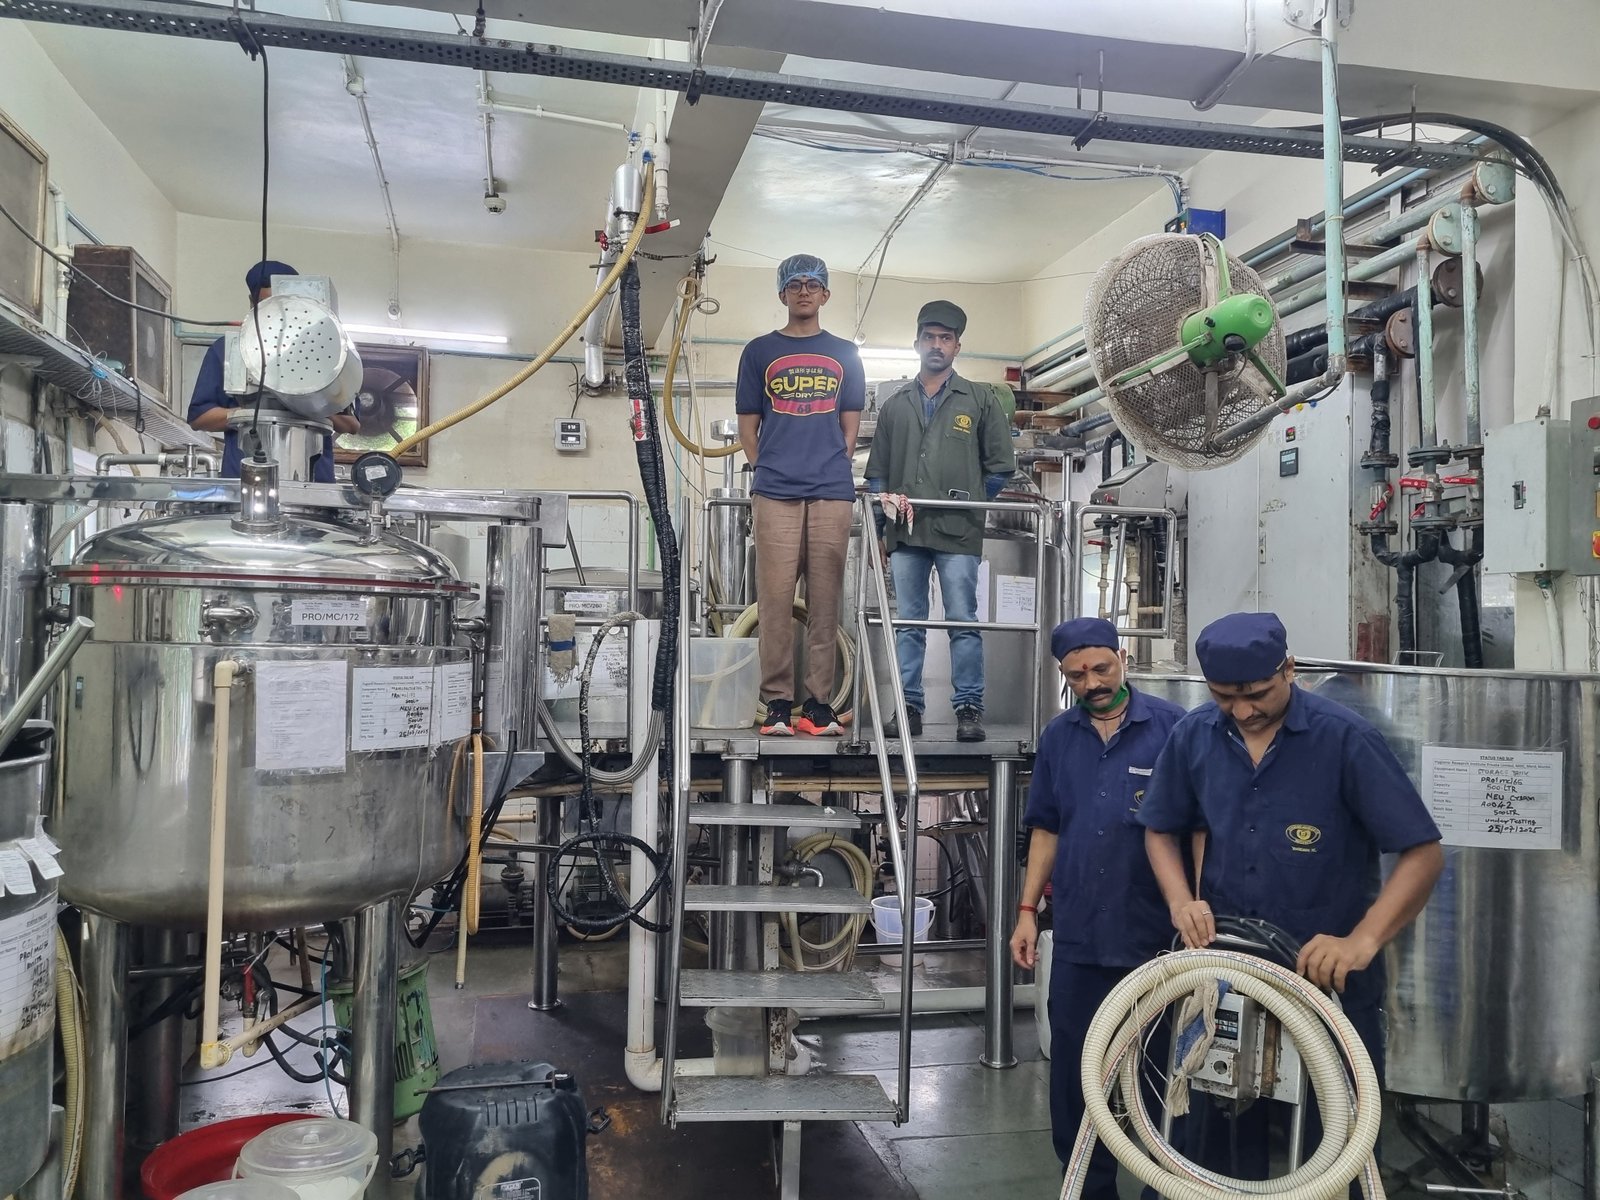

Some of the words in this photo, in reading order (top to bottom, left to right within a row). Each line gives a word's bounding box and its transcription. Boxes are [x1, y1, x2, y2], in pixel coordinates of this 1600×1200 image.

[770, 375, 838, 394] SUPER
[302, 613, 359, 621] PRO/MC/172
[1488, 824, 1542, 834] 25/07/2025
